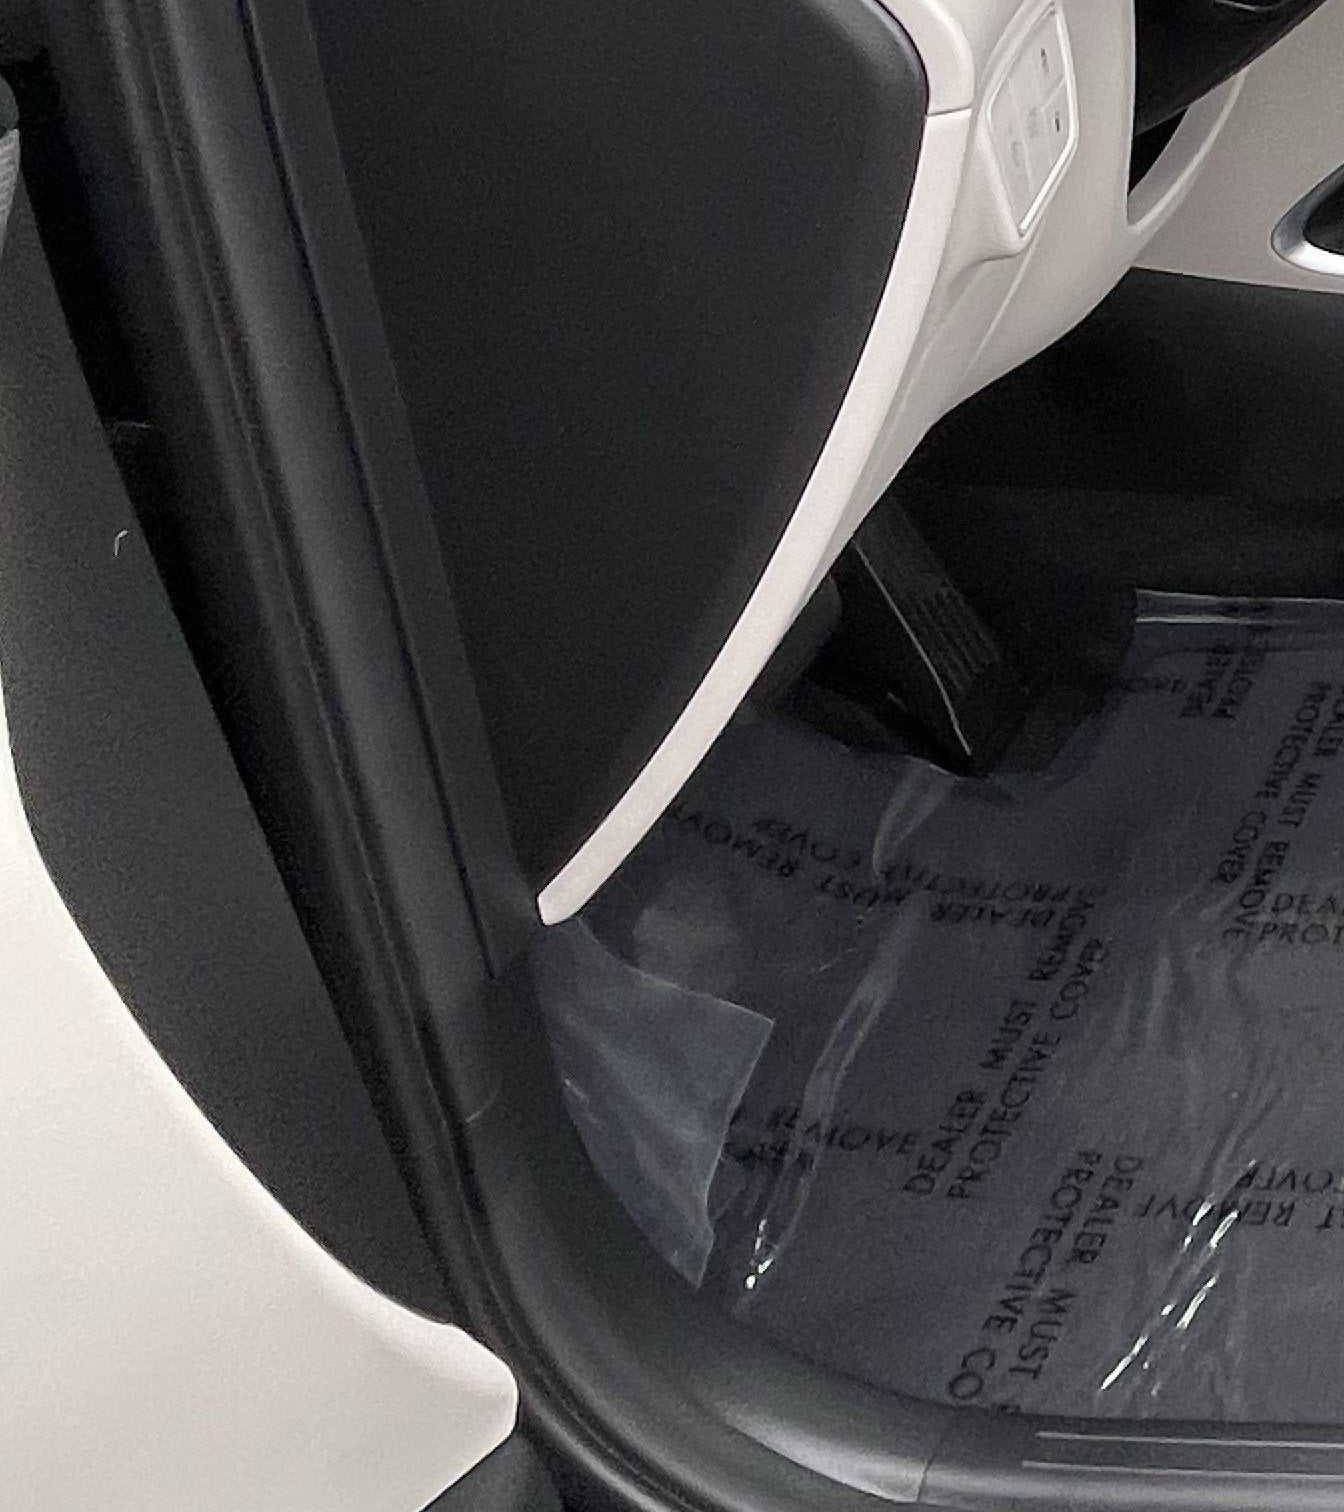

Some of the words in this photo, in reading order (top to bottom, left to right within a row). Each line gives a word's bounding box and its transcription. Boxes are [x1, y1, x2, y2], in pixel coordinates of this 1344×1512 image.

[1254, 680, 1333, 800] PROTECTIVE
[1209, 809, 1269, 886] COVER
[1276, 769, 1324, 829] MUST
[818, 874, 909, 908] MUST
[930, 901, 1058, 930] DEALER
[1222, 840, 1291, 940] REMOVE
[903, 1090, 989, 1195] DEALER
[979, 997, 1038, 1071] MUST
[947, 1031, 1062, 1199] PROTECTIVE
[1050, 938, 1106, 1021] COVER
[981, 1150, 1104, 1334] PROTECTIVE
[1062, 1155, 1146, 1271] DEALER
[1009, 1287, 1078, 1379] MUST
